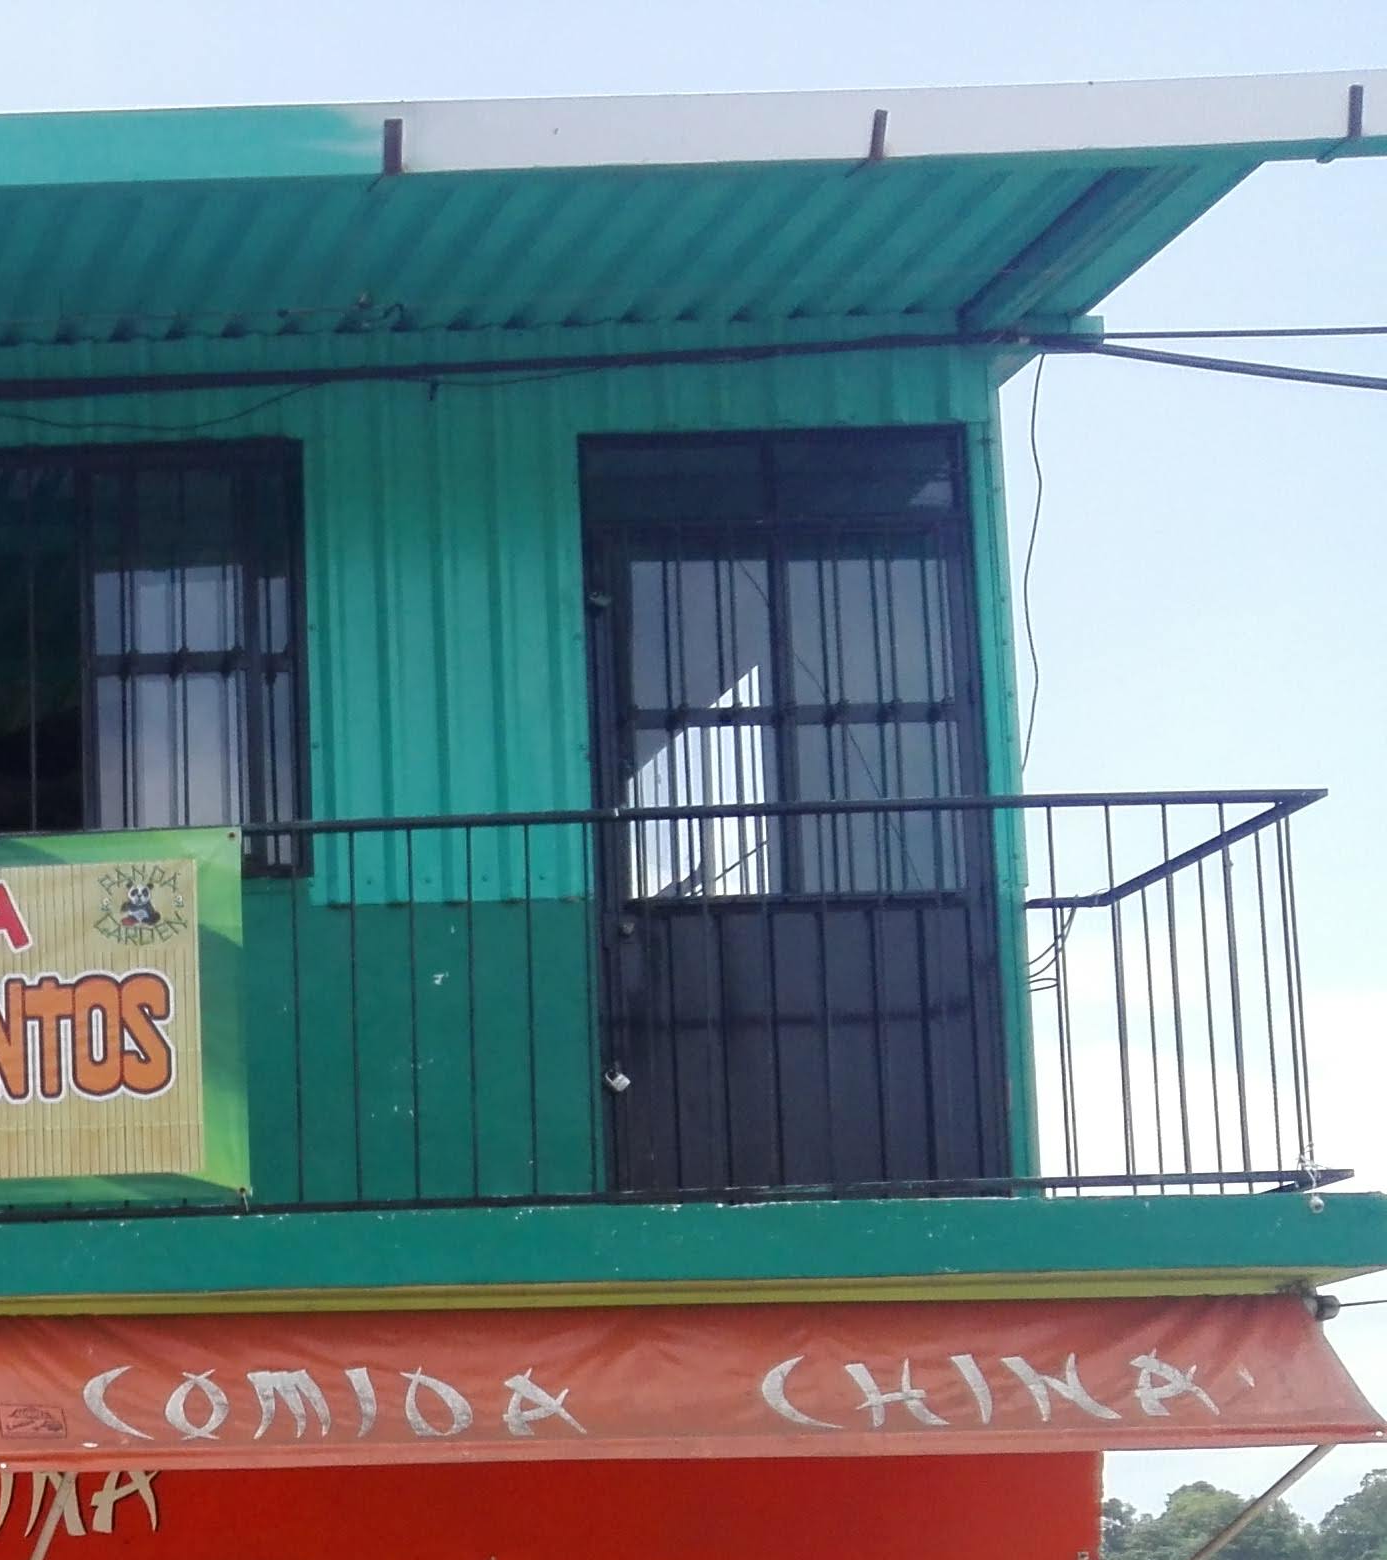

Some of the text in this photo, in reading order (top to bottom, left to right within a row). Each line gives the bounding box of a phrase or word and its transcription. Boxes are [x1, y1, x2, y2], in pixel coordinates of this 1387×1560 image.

[97, 864, 180, 896] PANDA
[82, 1365, 589, 1442] COMIDA
[761, 1349, 1223, 1432] CHINA
